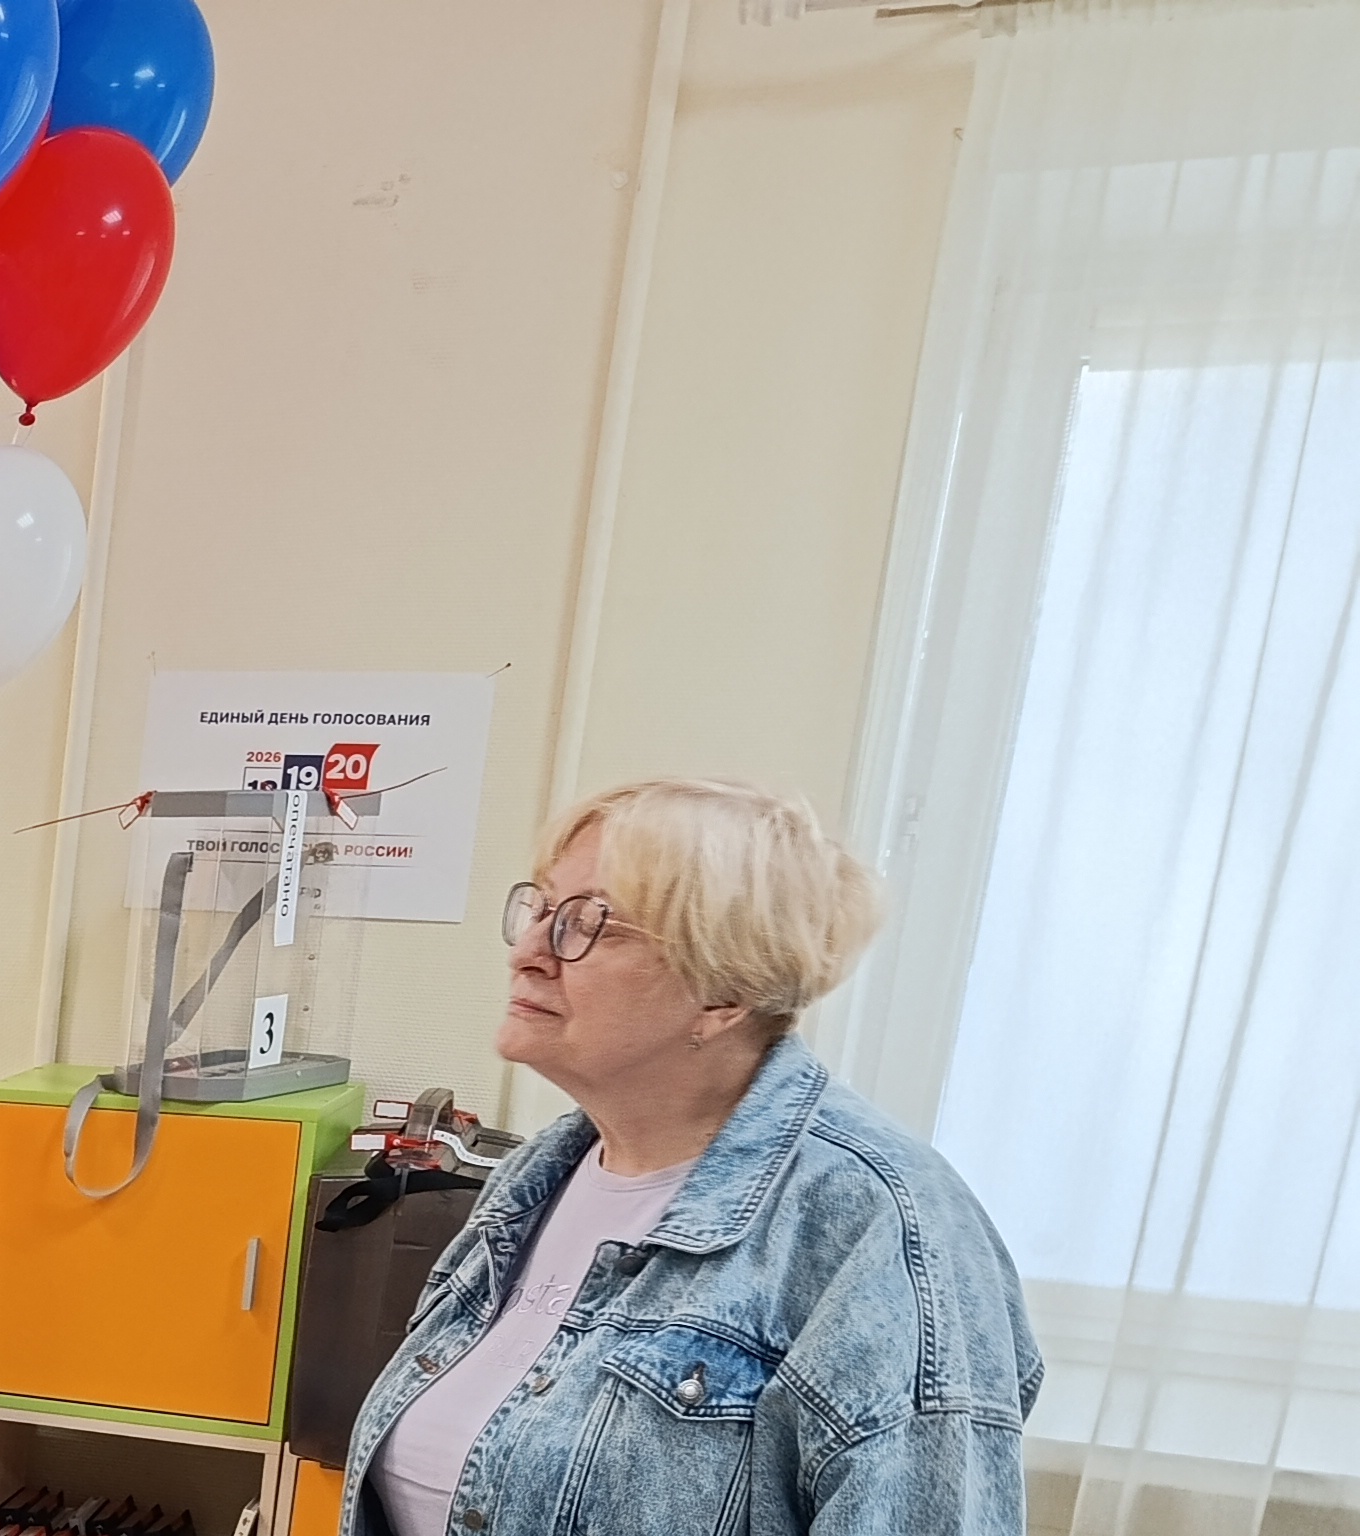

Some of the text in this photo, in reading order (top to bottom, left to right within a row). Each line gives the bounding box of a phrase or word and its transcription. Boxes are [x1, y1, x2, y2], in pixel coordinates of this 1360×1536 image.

[199, 709, 431, 727] ЕДИНЫЙ ДЕНЬ ГОЛОСОВАНИЯ
[246, 751, 282, 763] 2026
[325, 753, 368, 781] 20
[286, 765, 319, 791] 19
[186, 837, 228, 853] ТВОЙ
[230, 839, 281, 854] ГОЛОС
[343, 844, 414, 860] РОССИИ!
[279, 793, 301, 918] опечатано
[259, 1011, 275, 1055] 3
